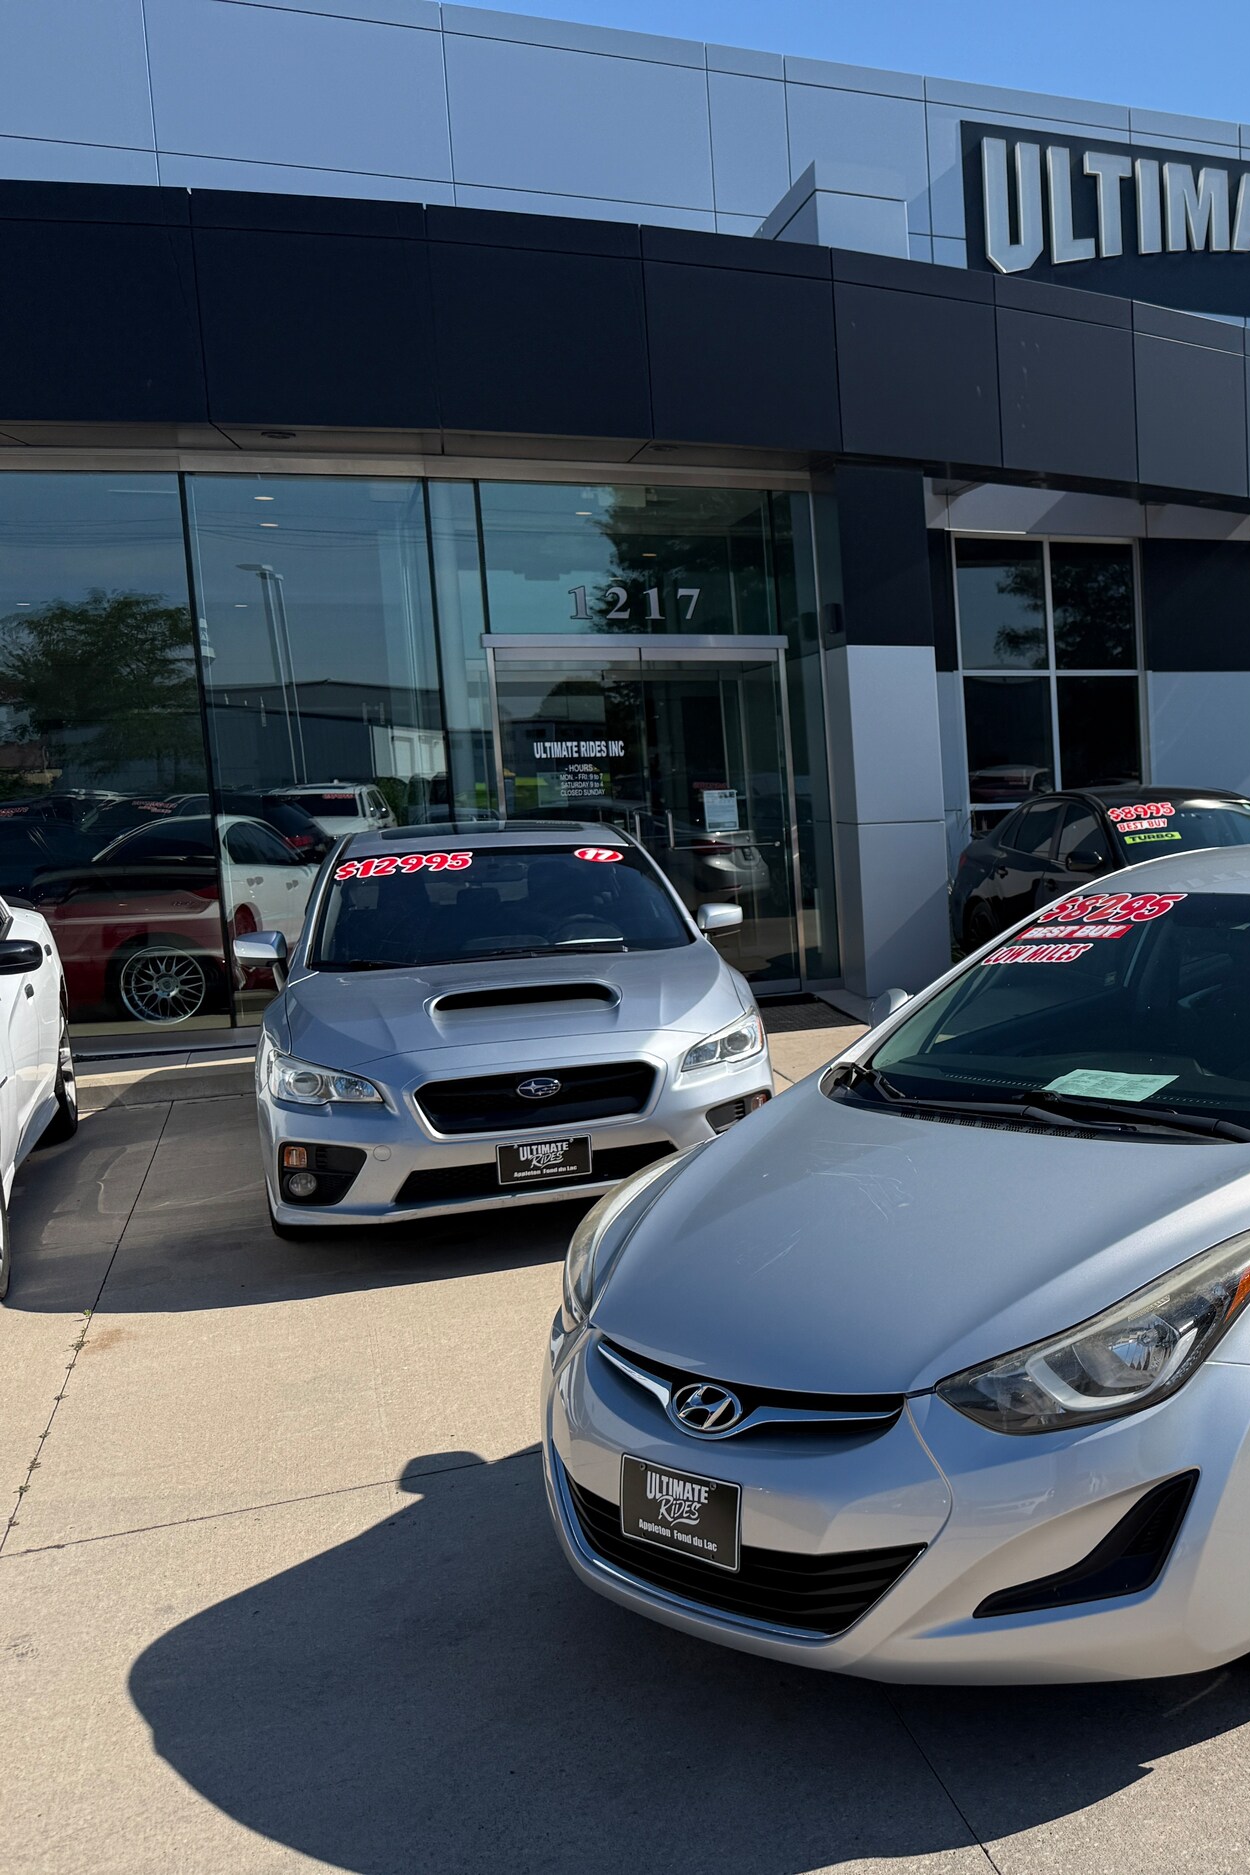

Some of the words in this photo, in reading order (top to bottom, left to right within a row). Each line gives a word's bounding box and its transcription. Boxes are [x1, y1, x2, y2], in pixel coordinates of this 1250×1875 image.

[568, 585, 701, 620] 1217
[533, 741, 579, 758] ULTIMATE
[580, 741, 607, 758] RIDES
[608, 740, 625, 757] INC
[569, 763, 594, 772] HOURS
[560, 781, 589, 789] SATURDAY
[560, 789, 583, 797] CLOSED
[583, 788, 606, 796] SUNDAY
[1108, 802, 1176, 821] $8995
[1117, 821, 1145, 832] BEST
[1146, 818, 1168, 829] BUY
[1129, 832, 1176, 842] TURBO
[584, 848, 612, 862] 17
[334, 851, 473, 880] $12995
[1021, 925, 1075, 939] BEST
[1073, 925, 1125, 938] BUY
[981, 945, 1030, 966] LOW
[1021, 943, 1094, 964] MILES
[519, 1141, 569, 1161] ULTIMATE
[513, 1169, 541, 1178] Appleton
[543, 1166, 558, 1174] Fond
[646, 1471, 709, 1503] ULTIMATE
[638, 1518, 671, 1537] Appleton
[673, 1529, 692, 1544] Fond
[692, 1536, 703, 1548] du
[704, 1539, 718, 1552] Lac
